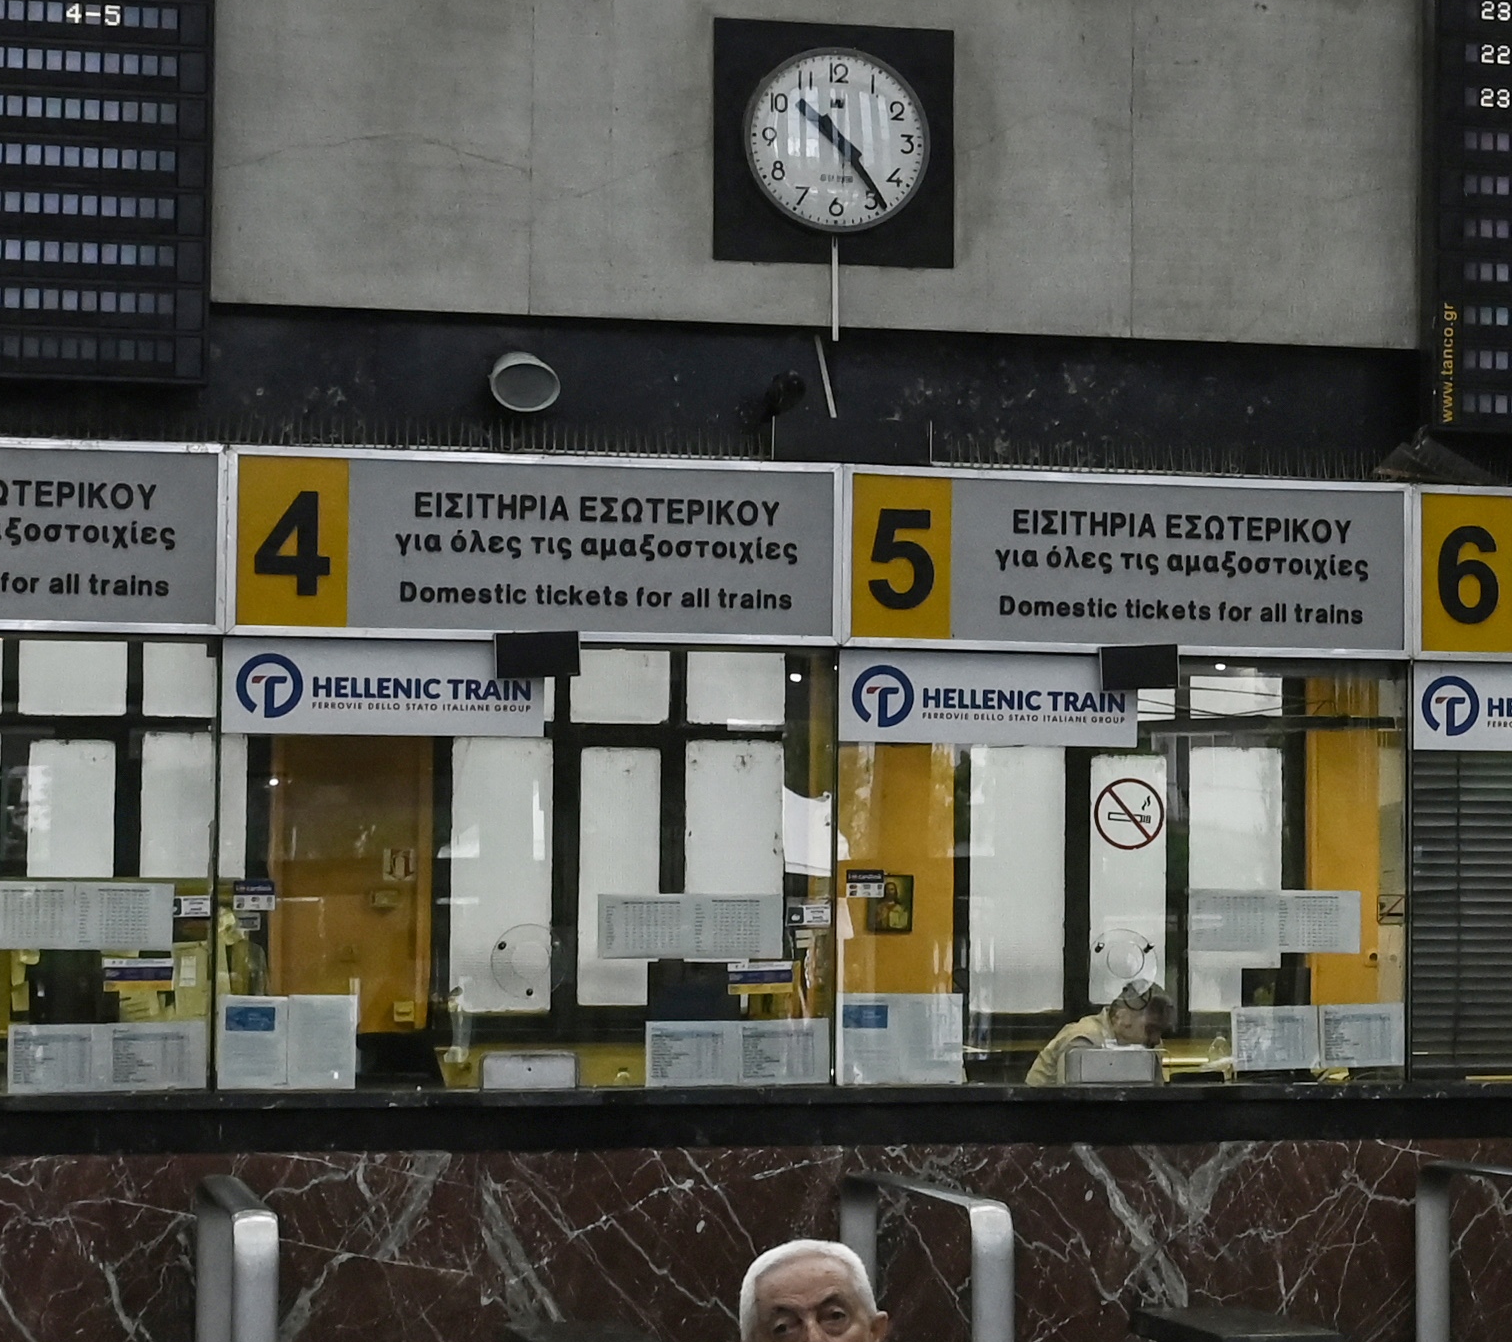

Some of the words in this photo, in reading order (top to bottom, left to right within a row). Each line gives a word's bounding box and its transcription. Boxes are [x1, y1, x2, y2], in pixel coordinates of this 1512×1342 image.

[65, 3, 121, 26] 4-5
[798, 70, 813, 90] 11
[829, 63, 849, 84] 12
[870, 74, 876, 94] 1
[770, 92, 788, 113] 10
[890, 101, 905, 121] 2
[762, 126, 777, 146] 9
[900, 134, 914, 154] 3
[772, 160, 785, 181] 8
[886, 167, 902, 187] 4
[795, 186, 810, 206] 7
[864, 191, 877, 211] 5
[829, 197, 844, 217] 6
[1440, 302, 1458, 423] www.tanco.gr
[414, 491, 570, 522] ΕΙΣΙΤΗΡΙΑ
[579, 496, 780, 527] ΕΣΩΤΕΡΙΚΟΥ
[1013, 508, 1157, 539] ΕΙΣΙΤΗΡΙΑ
[1165, 513, 1352, 545] ΕΣΩΤΕΡΙΚΟΥ
[253, 490, 331, 597] 4
[868, 508, 935, 611] 5
[0, 571, 40, 594] for
[48, 573, 80, 595] all
[88, 573, 169, 597] trains
[1437, 525, 1499, 626] 6
[999, 595, 1118, 619] Domestic
[1125, 598, 1211, 621] tickets
[1218, 601, 1253, 623] for
[1260, 602, 1287, 623] all
[1294, 603, 1363, 625] trains
[312, 676, 442, 700] HELLENIC
[446, 674, 536, 702] TRAIN
[922, 687, 1042, 711] HELLENIC
[1046, 686, 1130, 714] TRAIN
